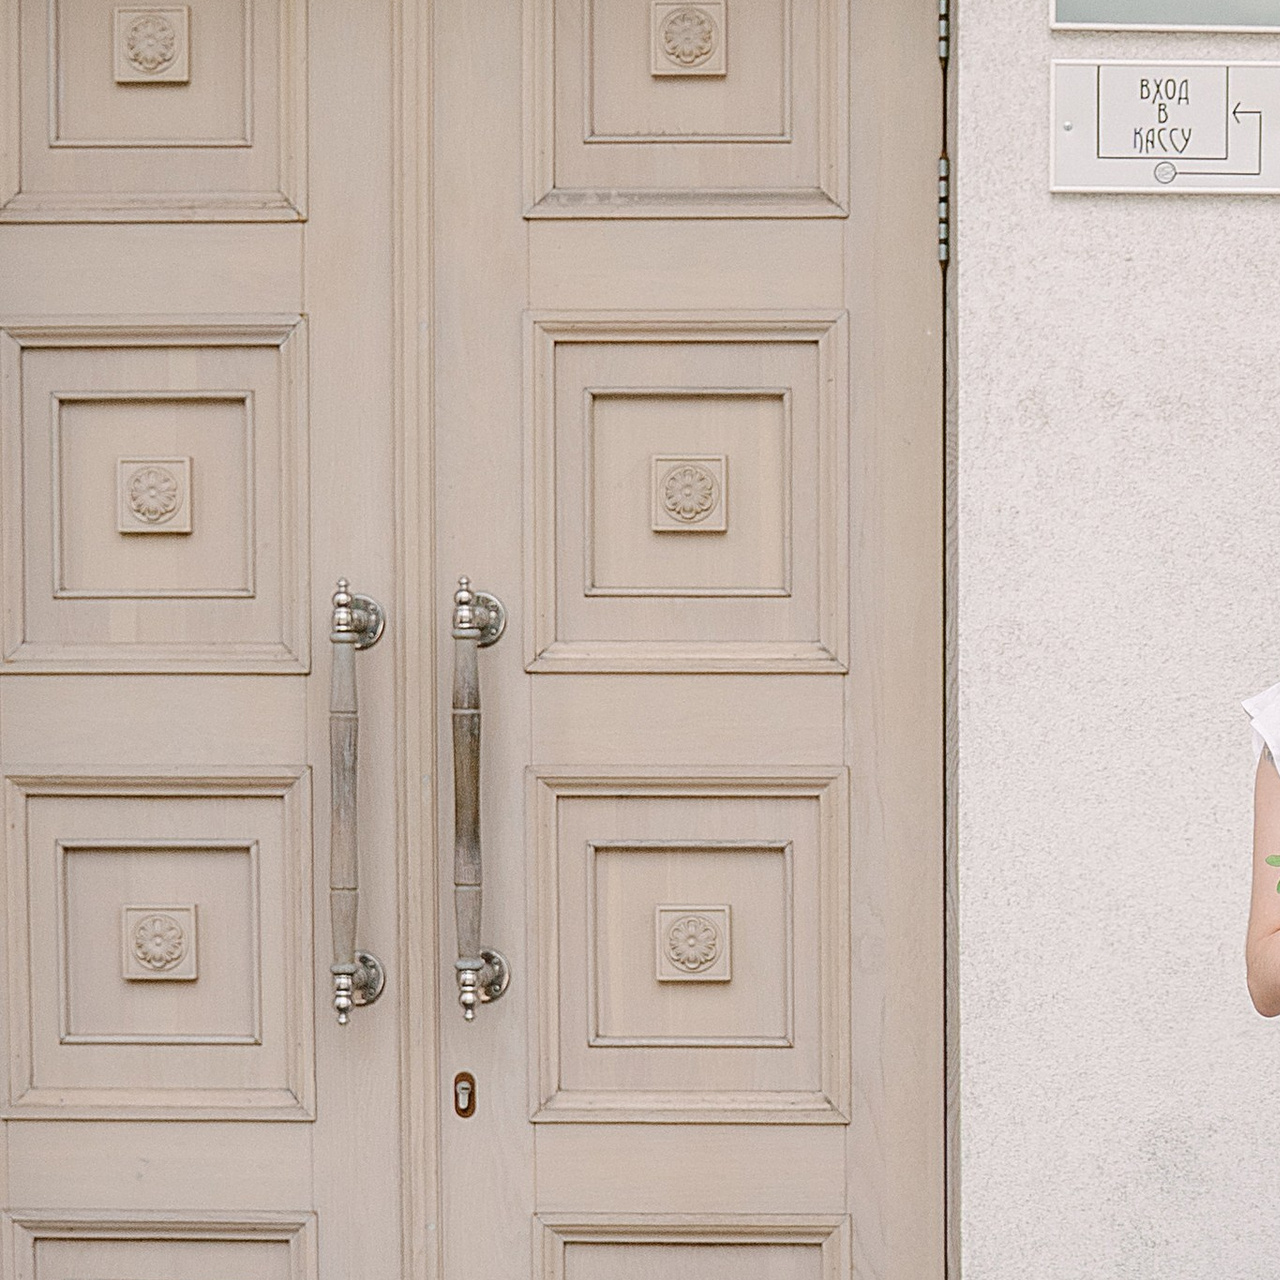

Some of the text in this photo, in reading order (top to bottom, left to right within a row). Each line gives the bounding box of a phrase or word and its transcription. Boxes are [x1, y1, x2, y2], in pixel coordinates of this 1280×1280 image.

[1140, 78, 1189, 104] ВХОД
[1158, 103, 1168, 124] В
[1133, 127, 1192, 154] КАССУ
